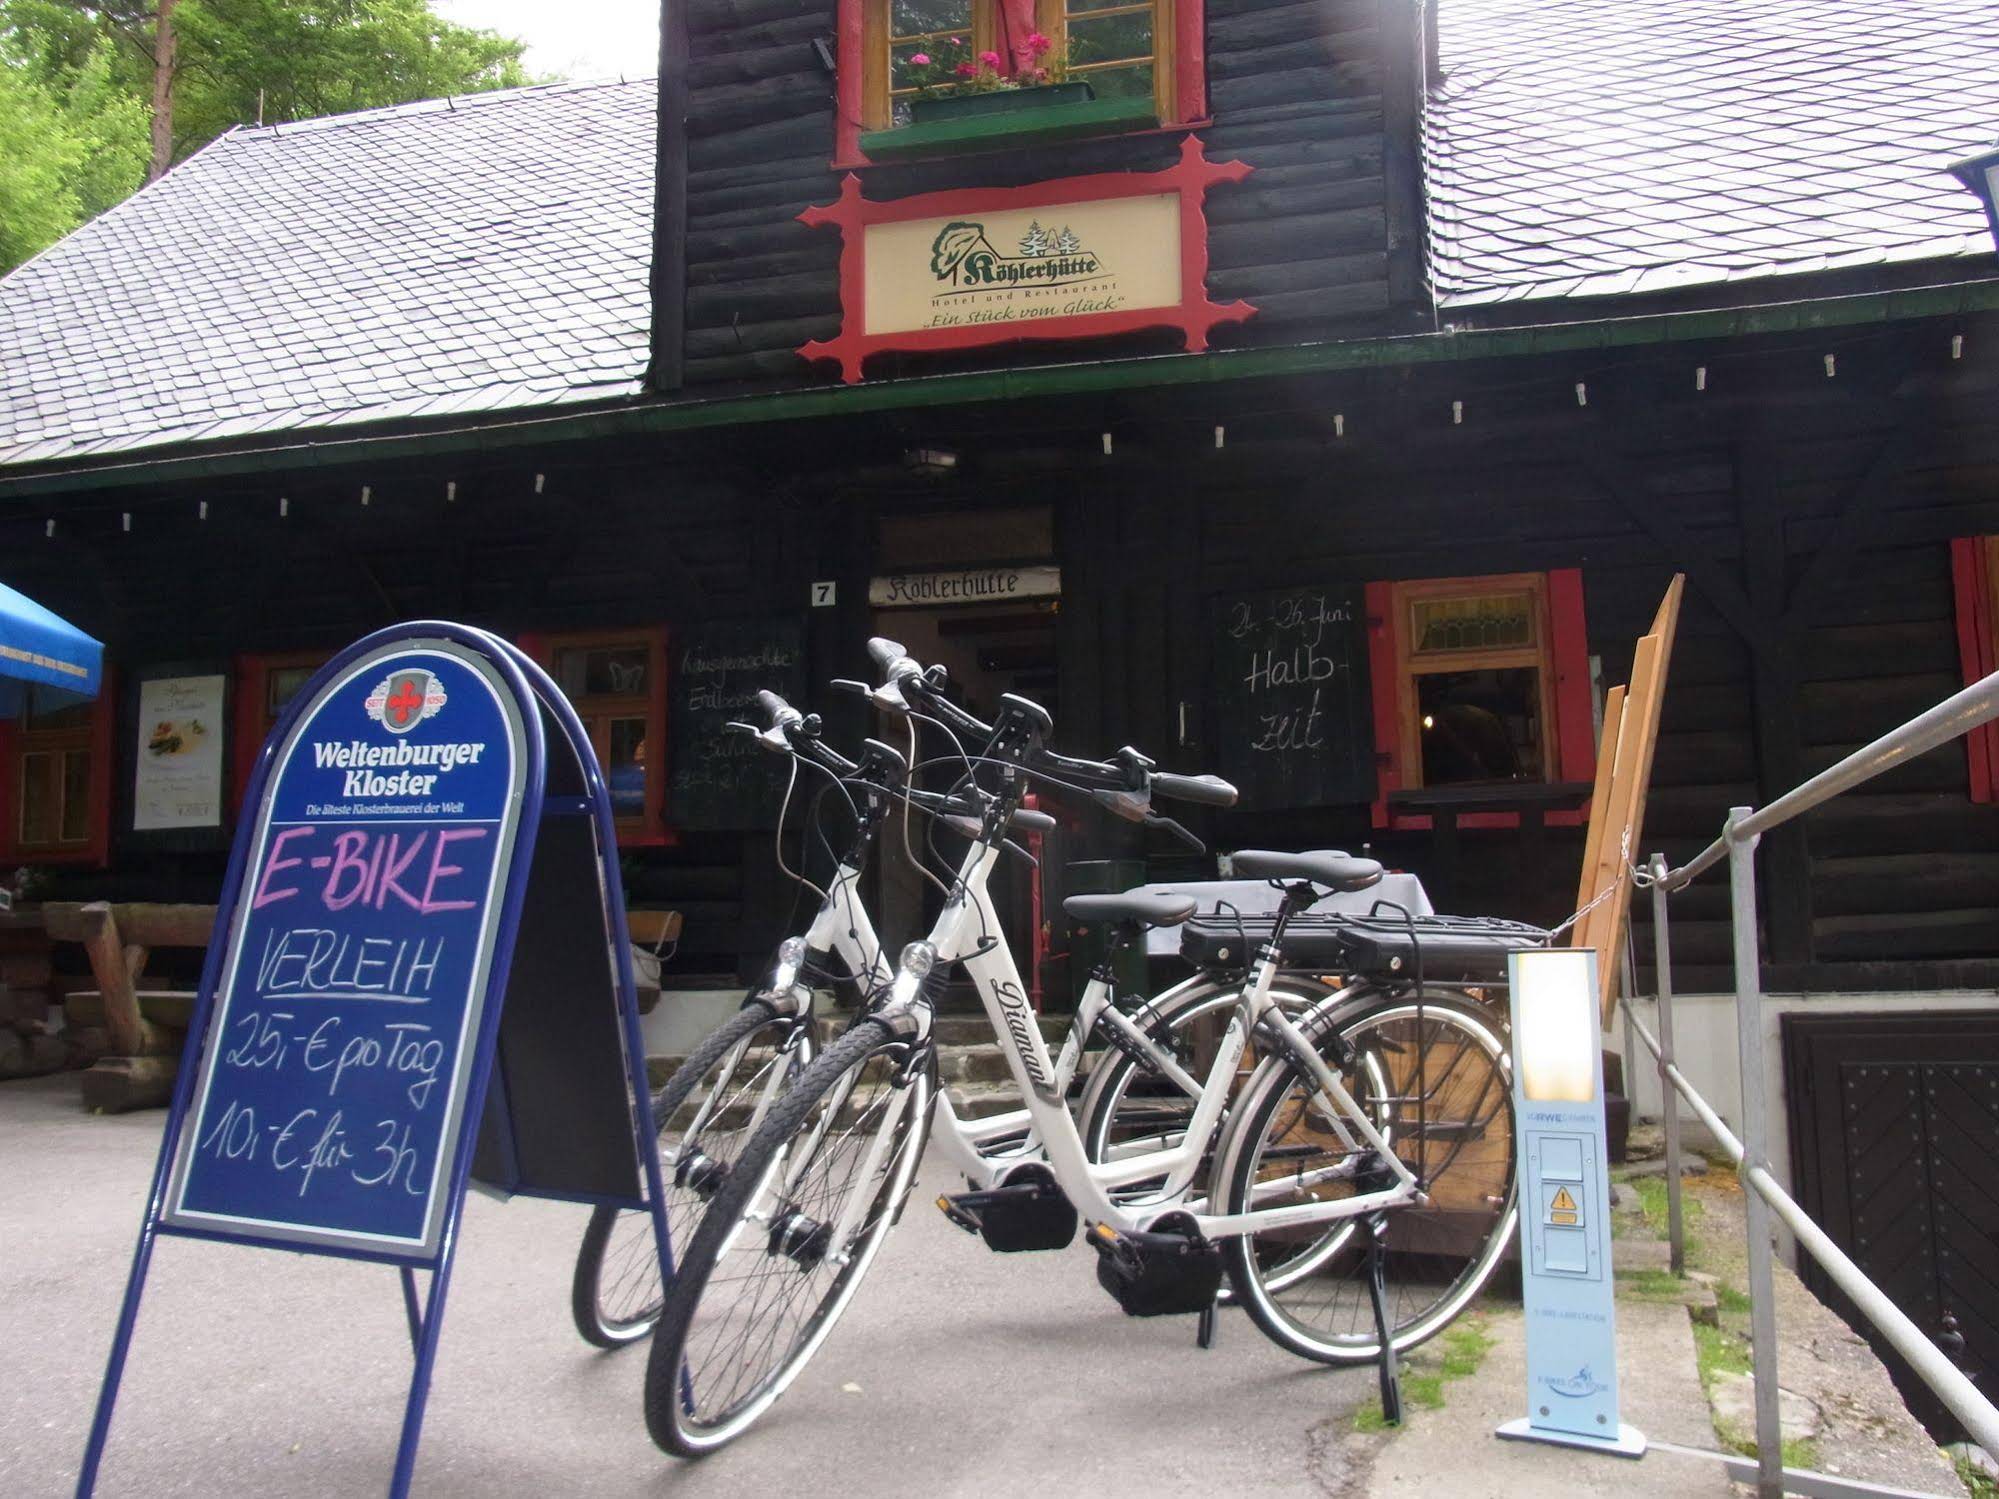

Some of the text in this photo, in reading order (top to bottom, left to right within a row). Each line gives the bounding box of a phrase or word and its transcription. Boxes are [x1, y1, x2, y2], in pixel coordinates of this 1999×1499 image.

[963, 250, 1098, 286] Köhlerhütte
[932, 282, 1120, 307] Hotel und Restaurant
[964, 306, 1015, 324] Stück
[1020, 306, 1056, 318] vom
[817, 585, 830, 602] 7
[313, 738, 485, 772] Weltenburger
[342, 769, 438, 797] Kloster
[306, 803, 321, 816] Die
[423, 802, 441, 814] der
[441, 801, 464, 814] Welt
[252, 825, 489, 916] E-BIKE
[256, 927, 445, 995] VERLEIH
[298, 1109, 354, 1197] für
